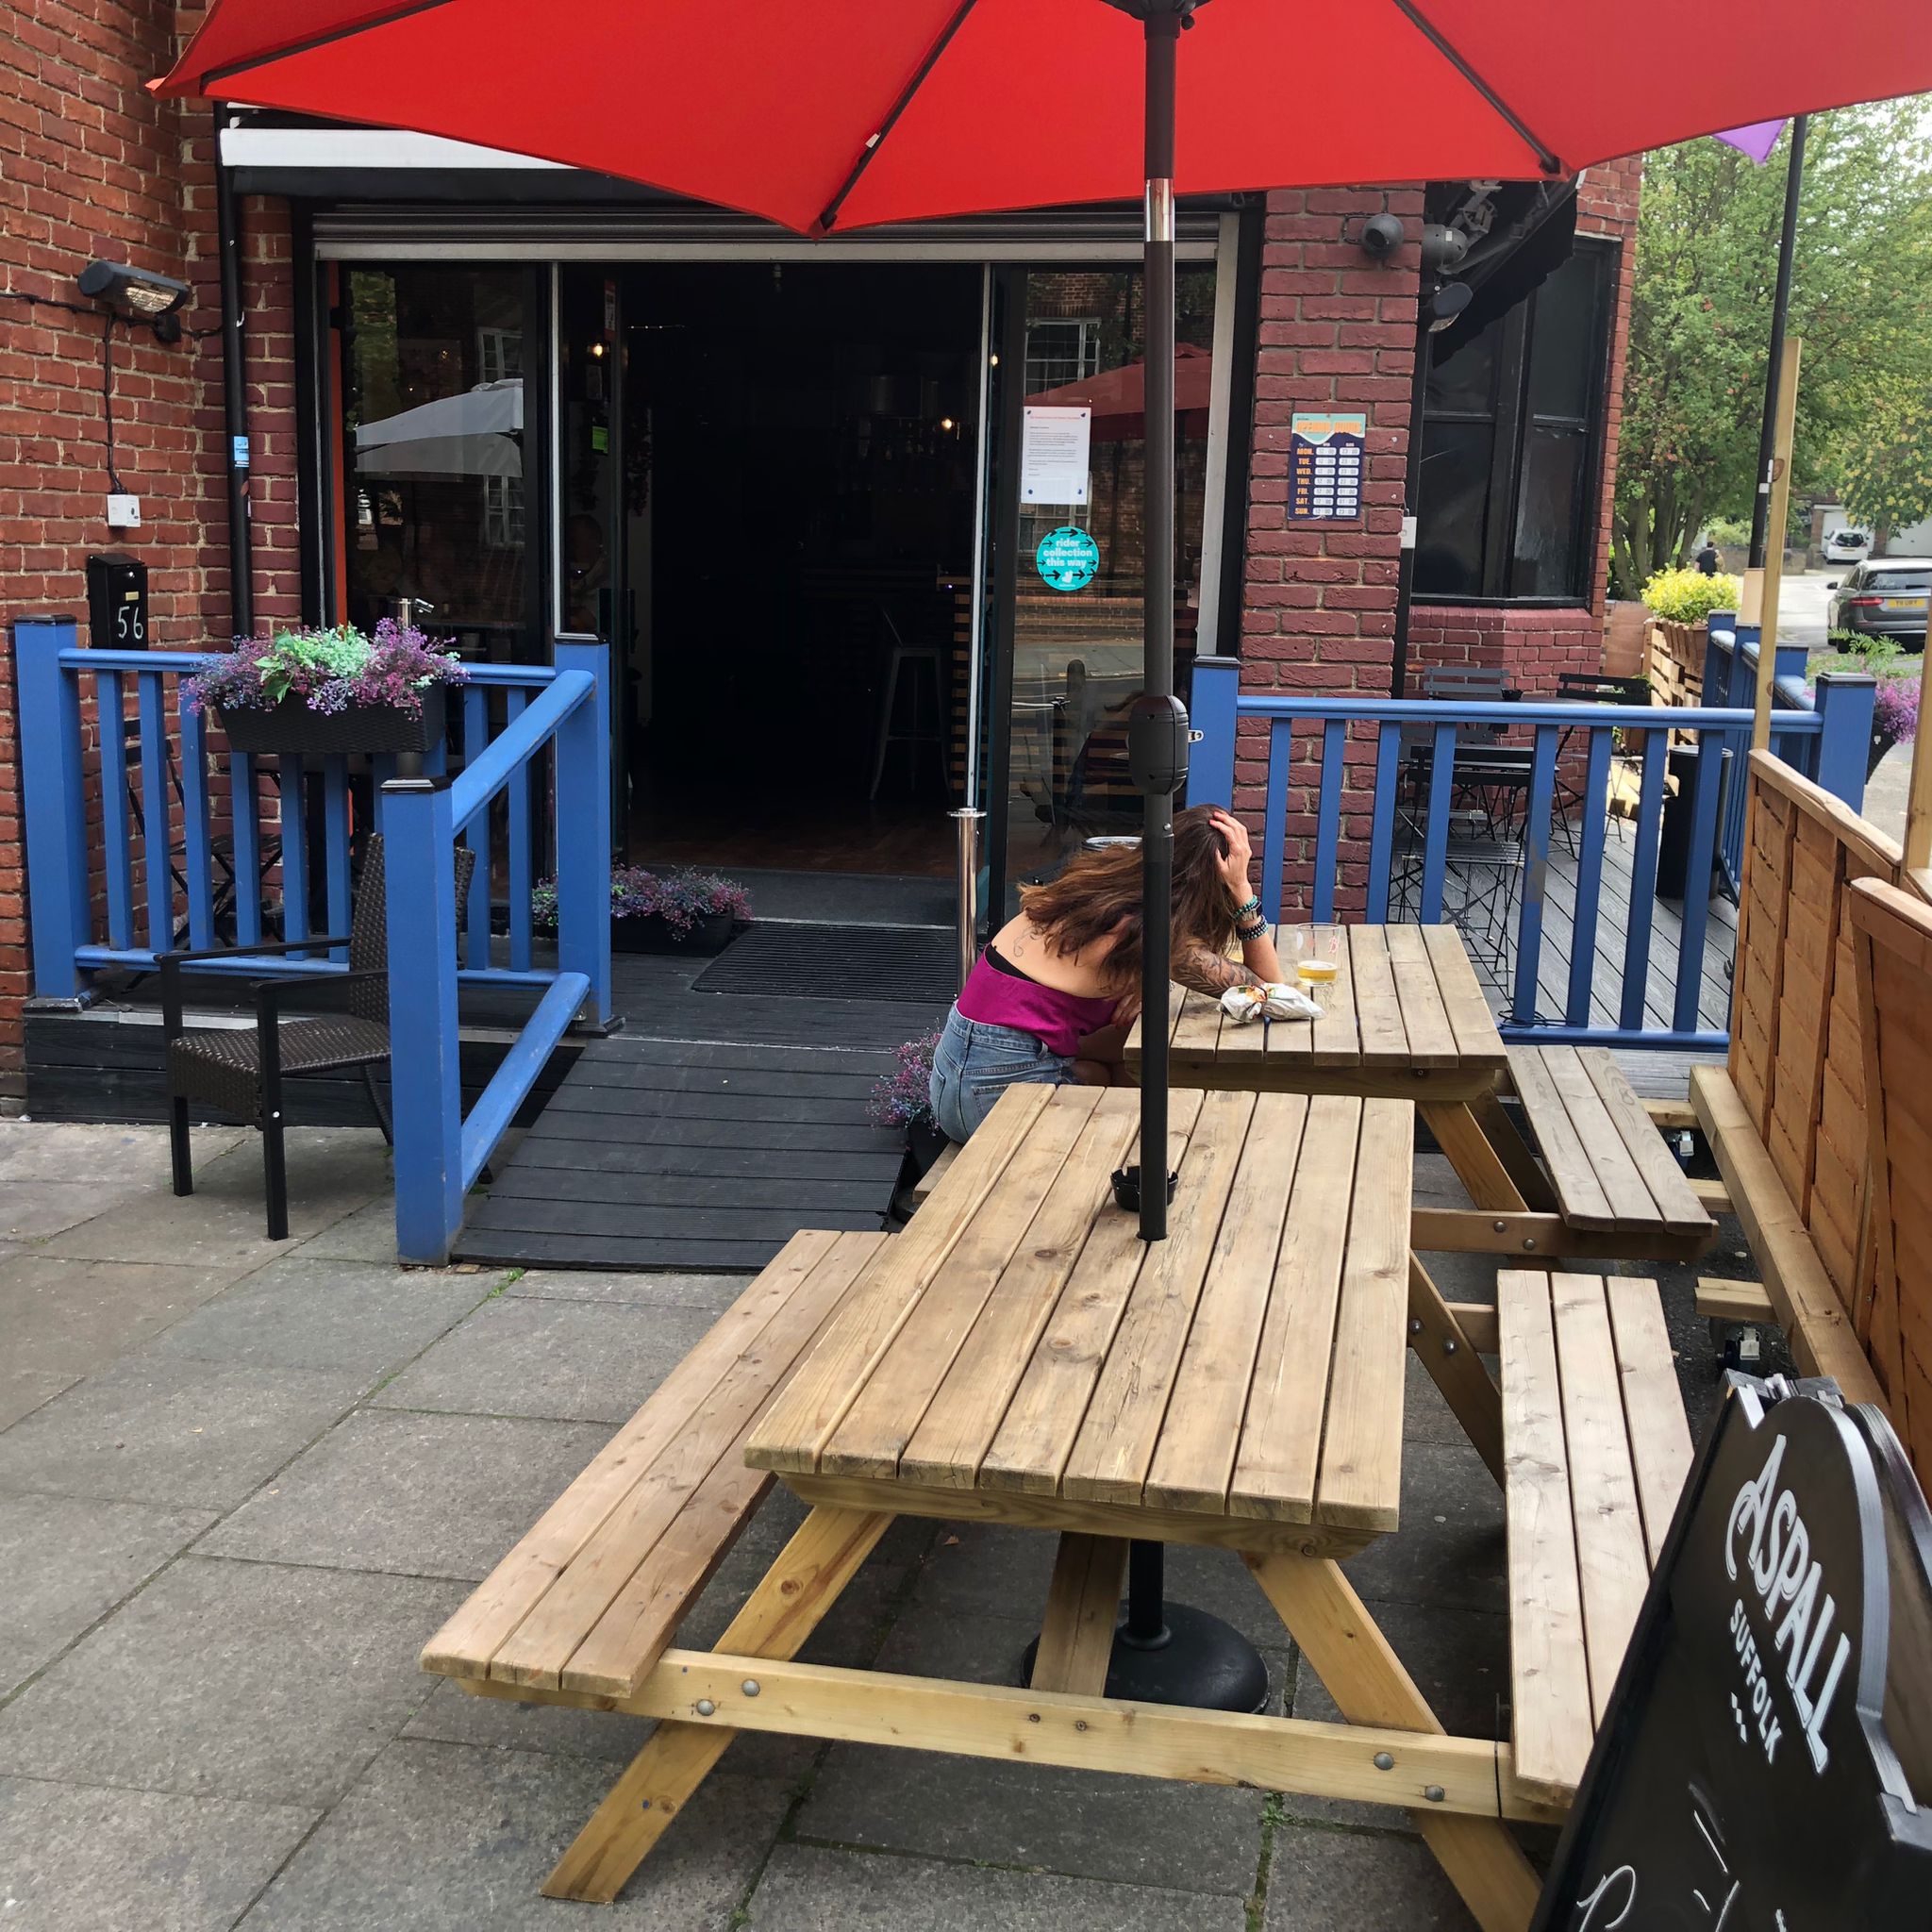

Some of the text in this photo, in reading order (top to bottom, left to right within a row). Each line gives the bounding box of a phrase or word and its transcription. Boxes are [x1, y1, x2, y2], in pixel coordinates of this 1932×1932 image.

[1043, 547, 1092, 557] collection
[1056, 538, 1080, 547] rider
[1046, 558, 1087, 568] this way
[117, 605, 144, 641] 56
[1724, 1433, 1850, 1774] ASPALL
[1729, 1598, 1783, 1765] SUFFOLK
